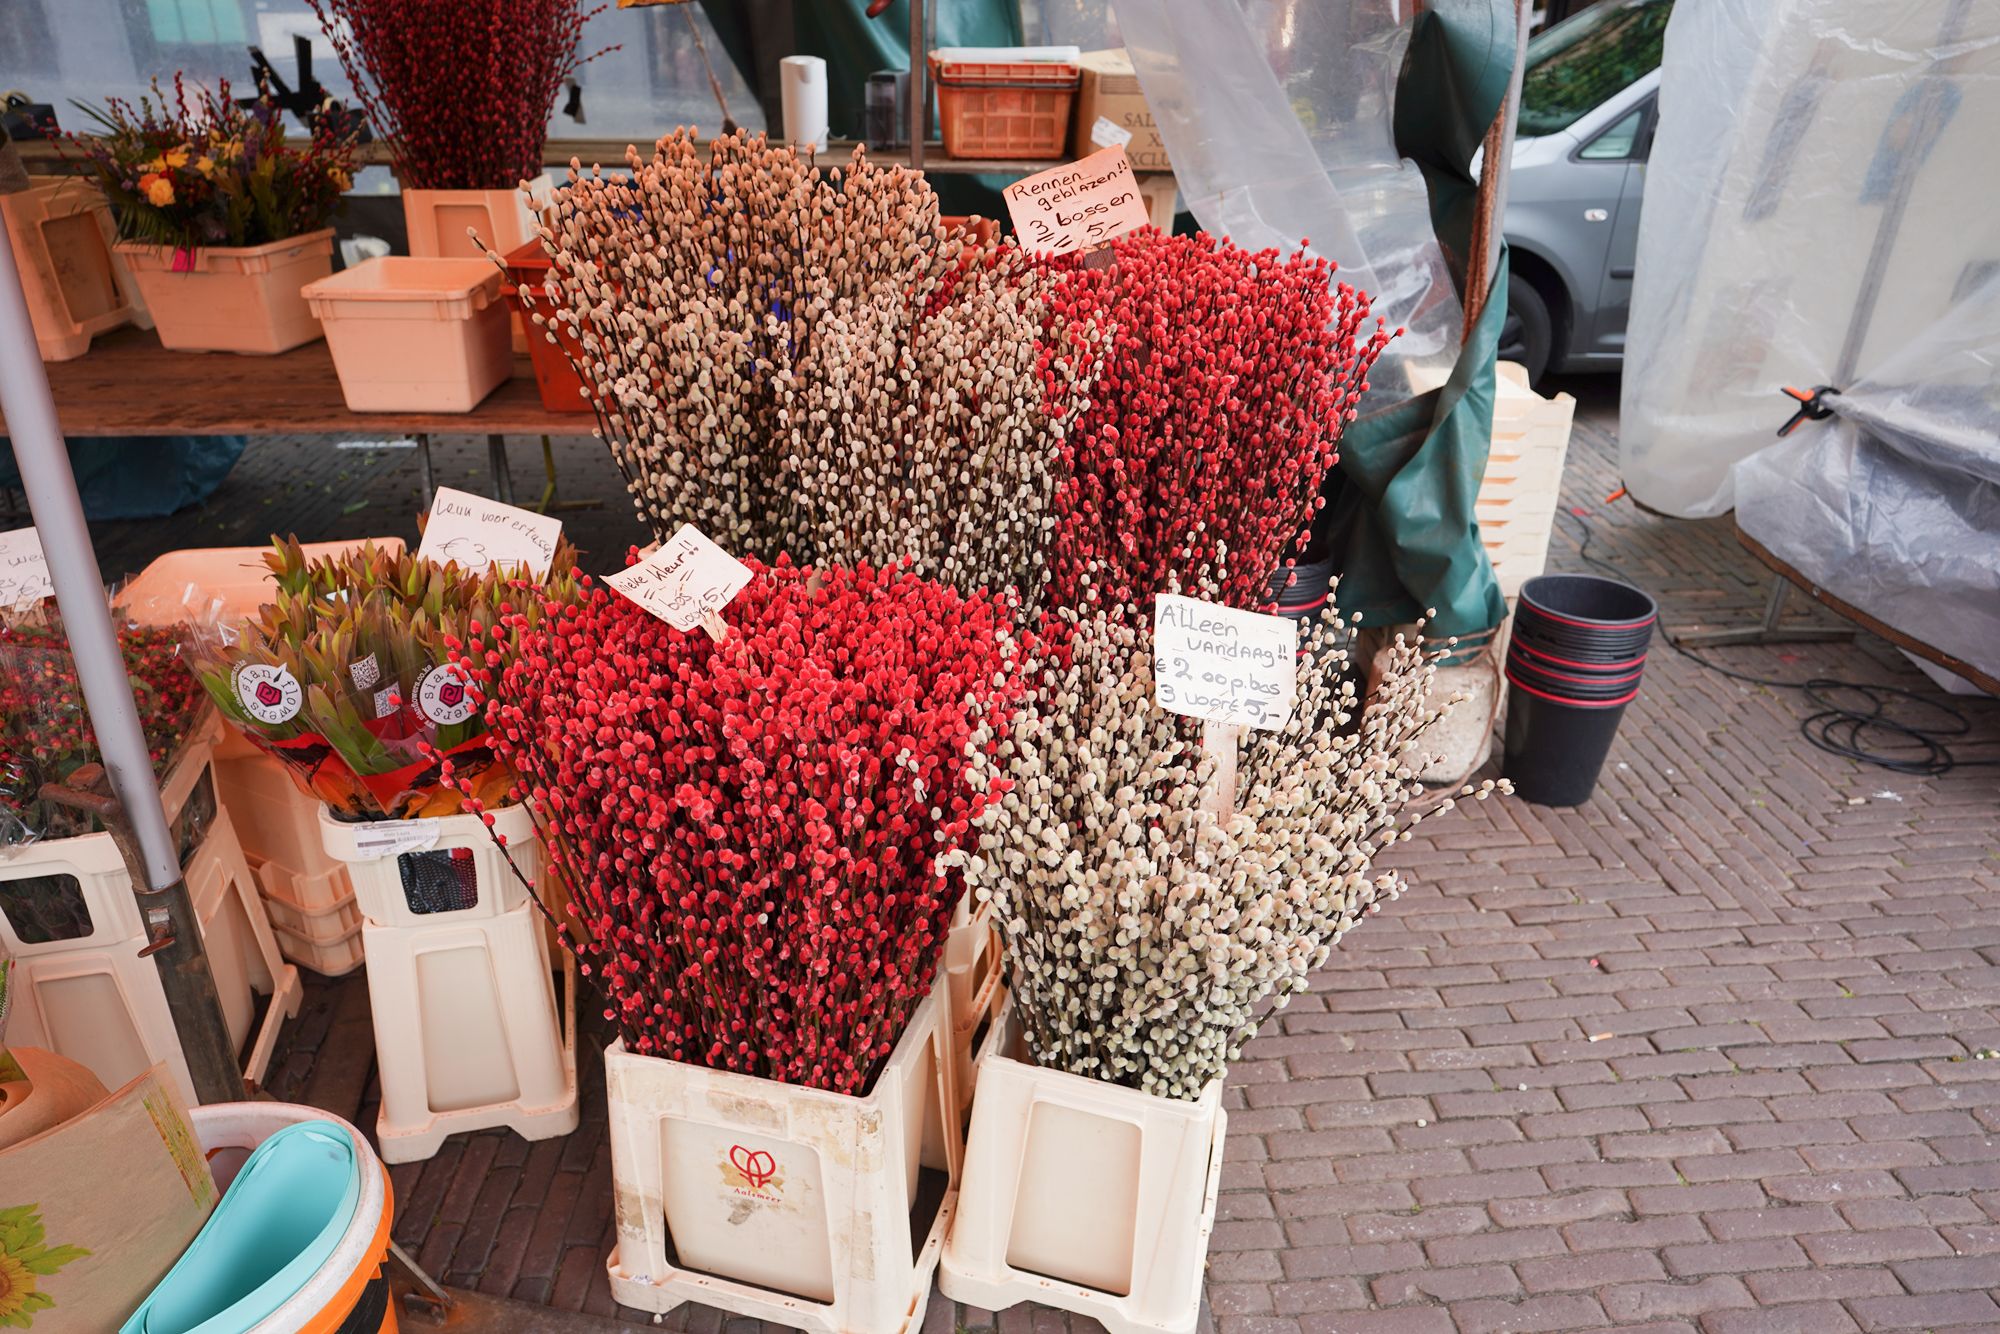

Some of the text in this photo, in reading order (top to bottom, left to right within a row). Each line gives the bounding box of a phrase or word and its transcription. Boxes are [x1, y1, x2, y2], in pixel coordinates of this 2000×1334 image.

[1011, 172, 1083, 201] Rennen
[1056, 192, 1134, 227] bossen
[481, 512, 510, 523] voor
[1160, 683, 1176, 704] 3
[734, 1187, 782, 1202] Aalsmeer
